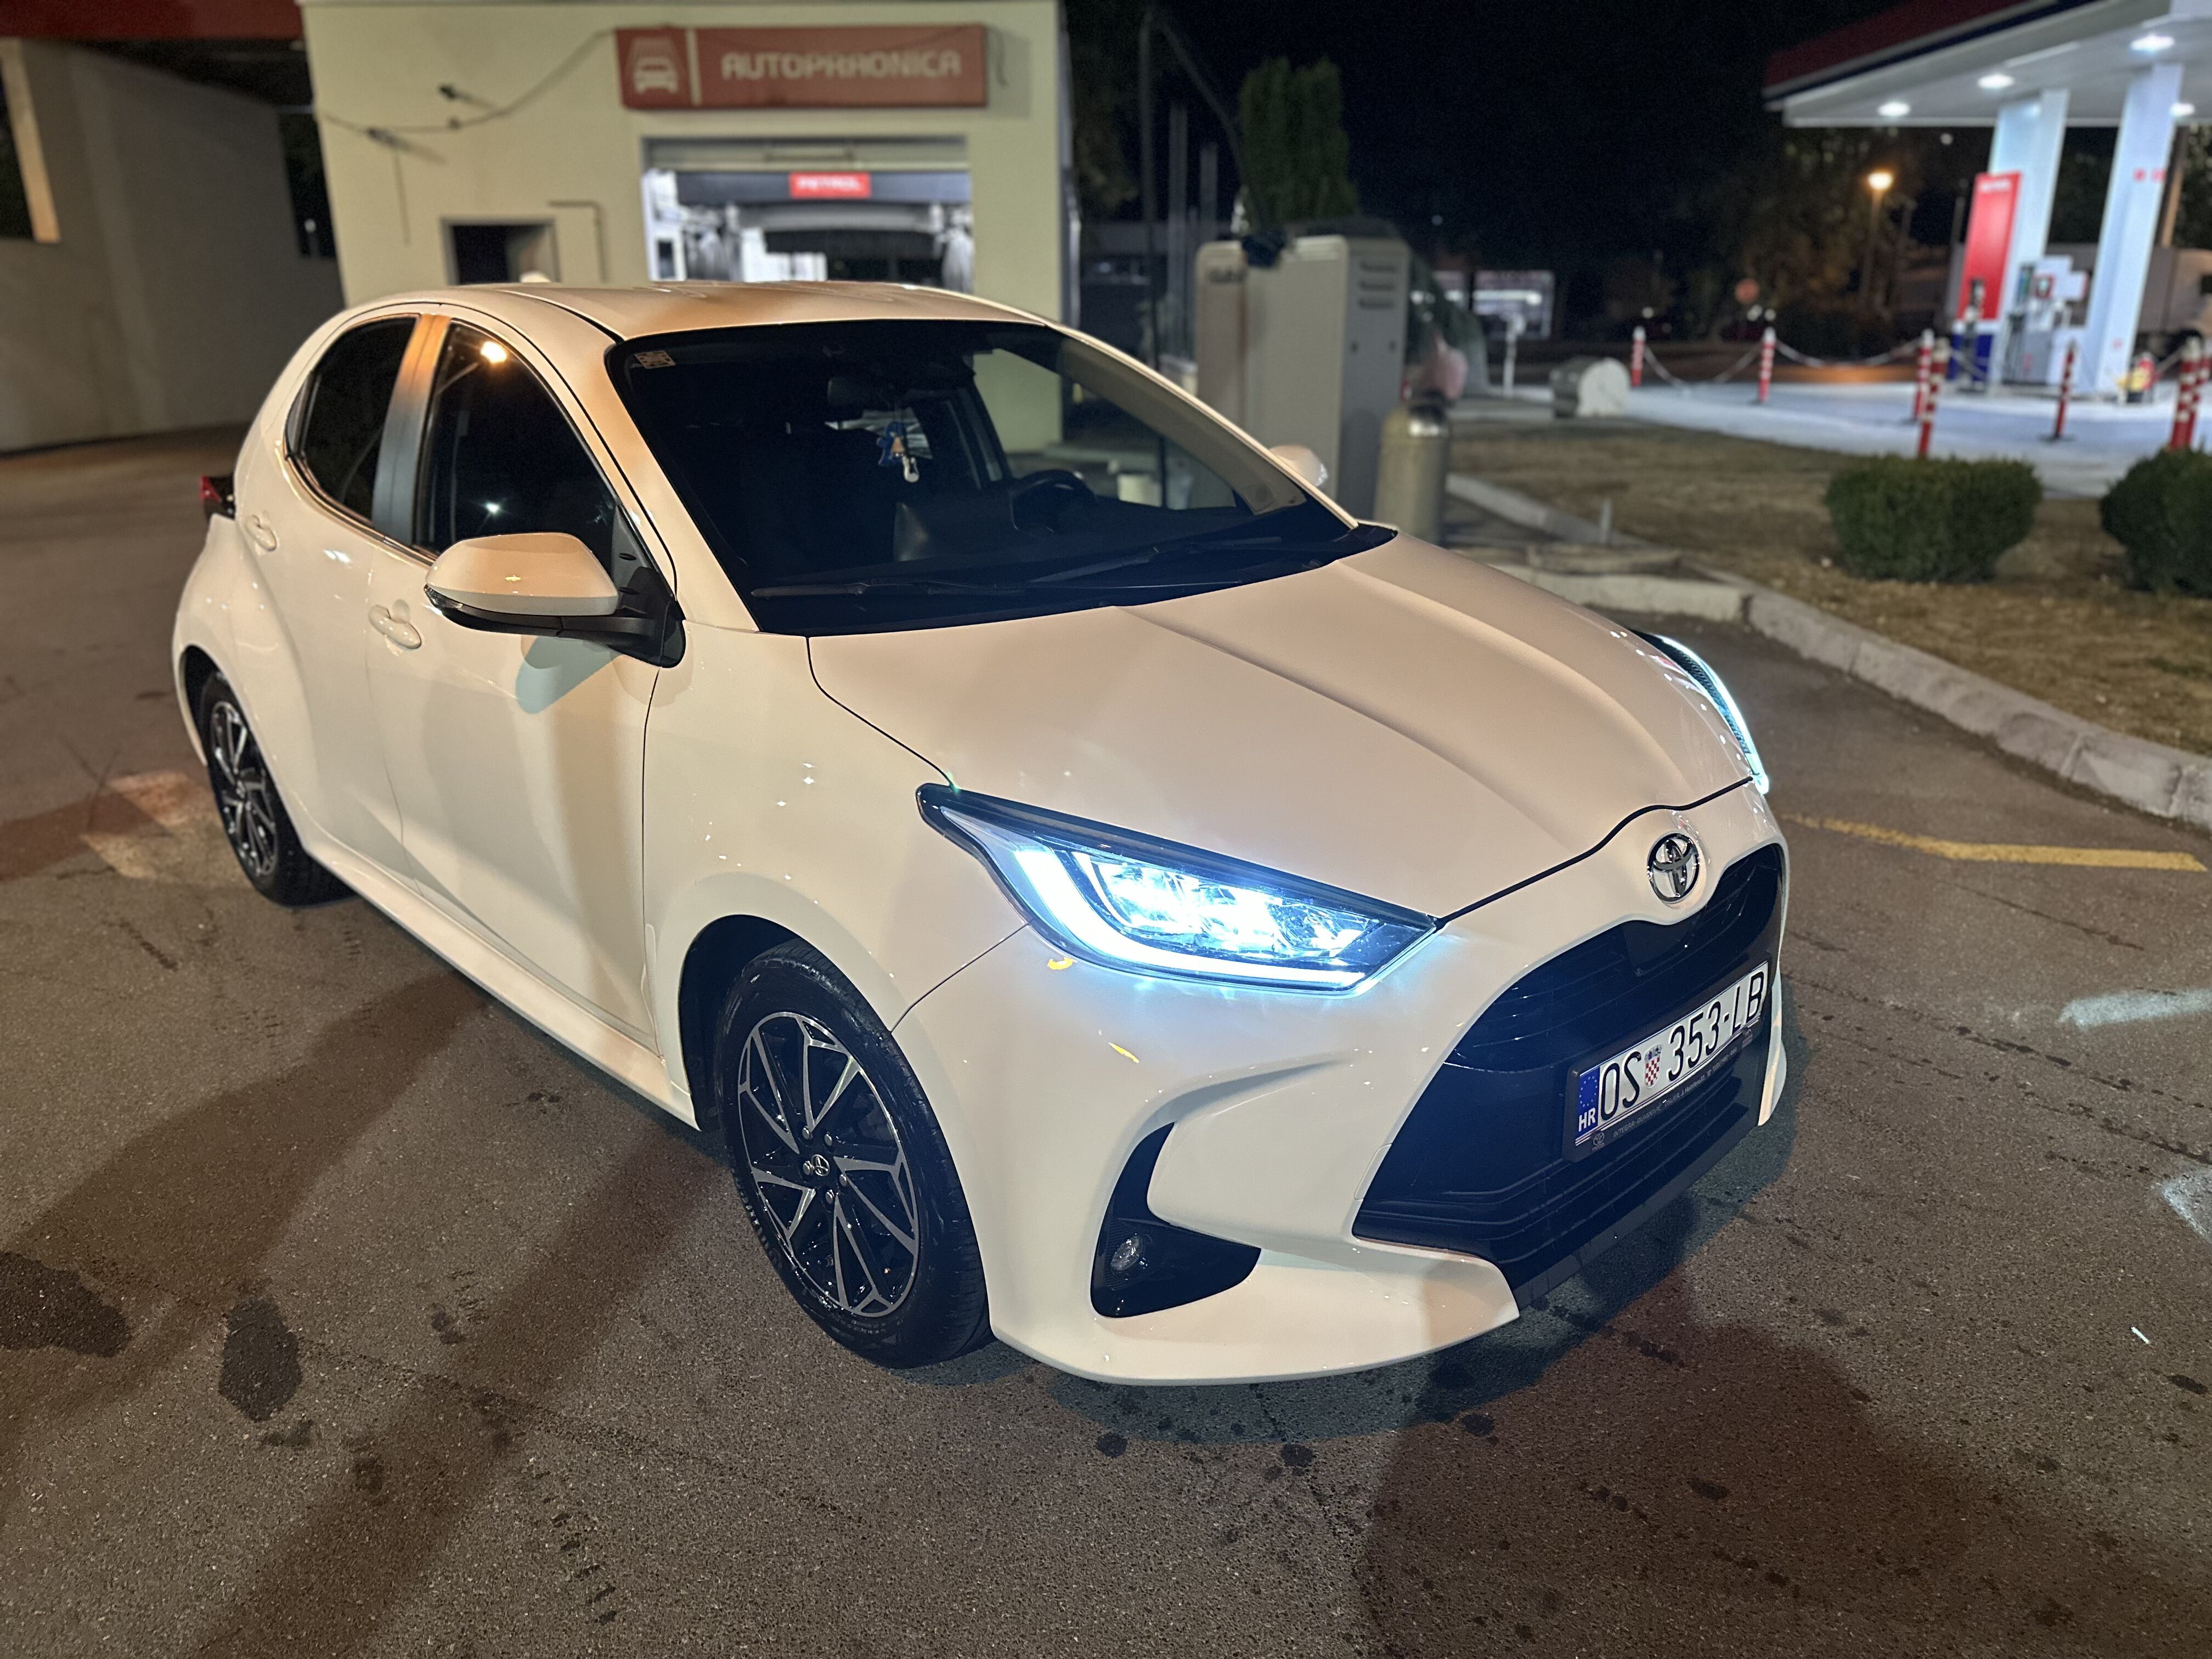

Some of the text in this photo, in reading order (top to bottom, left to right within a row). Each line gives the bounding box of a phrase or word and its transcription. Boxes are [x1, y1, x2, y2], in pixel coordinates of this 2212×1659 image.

[1600, 1050, 1642, 1121] OS
[1668, 971, 1764, 1082] 353-LB
[1578, 1107, 1596, 1132] HR
